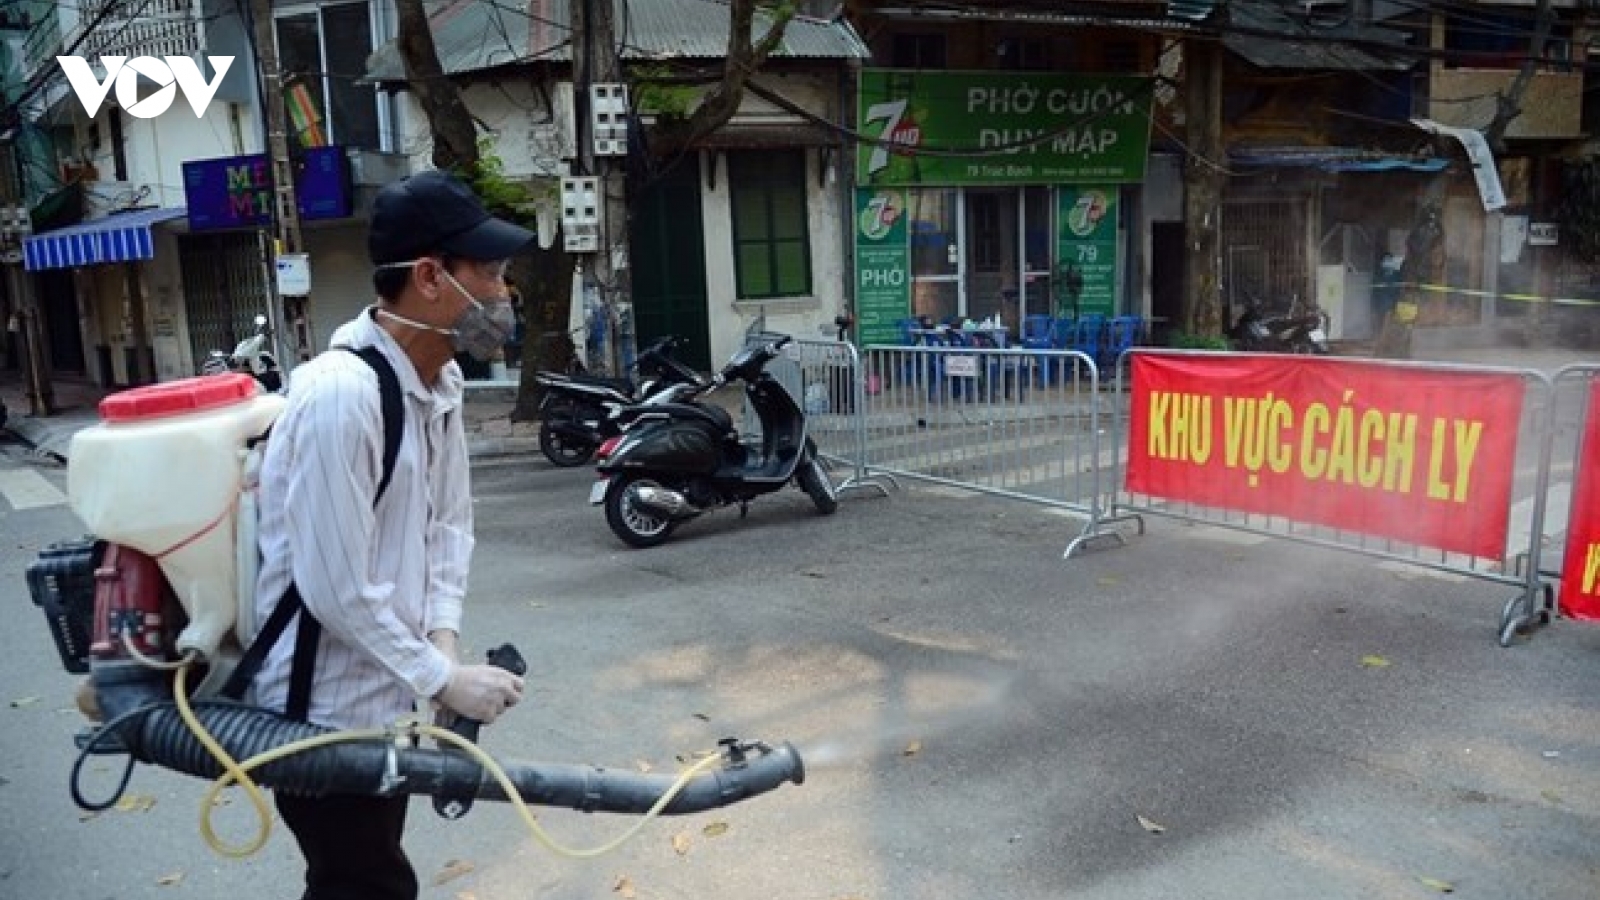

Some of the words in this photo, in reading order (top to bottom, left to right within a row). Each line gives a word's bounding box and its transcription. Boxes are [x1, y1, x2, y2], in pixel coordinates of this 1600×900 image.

[967, 82, 1040, 112] PHỞ
[1147, 390, 1212, 466] KHU
[1223, 391, 1294, 487] VỰC
[1300, 389, 1417, 494] CÁCH
[1426, 417, 1482, 503] LY
